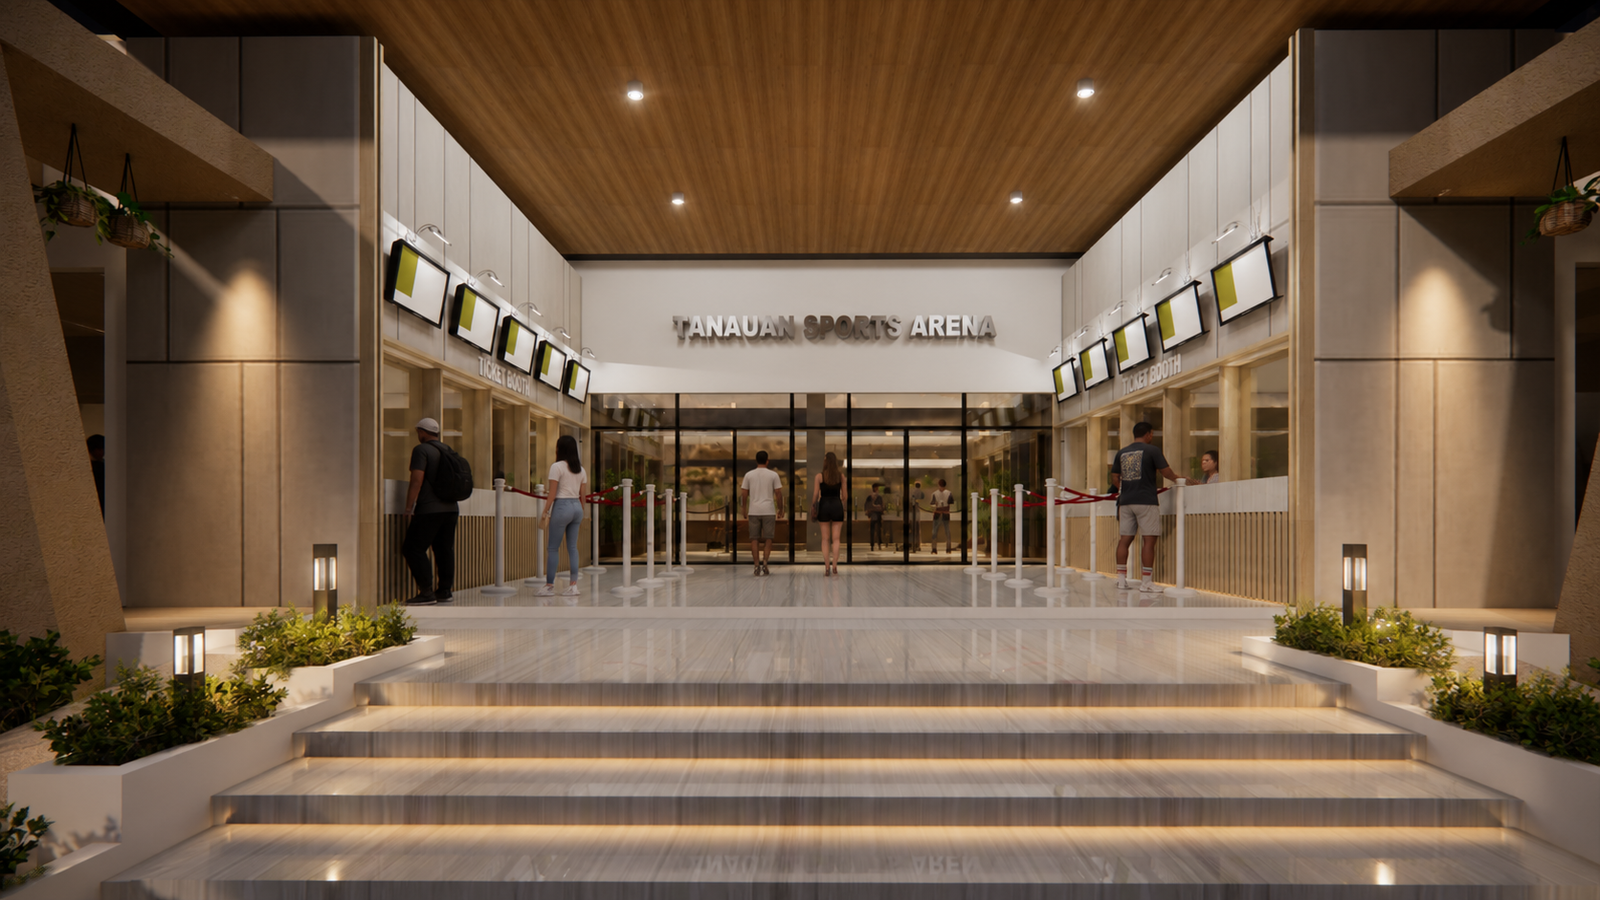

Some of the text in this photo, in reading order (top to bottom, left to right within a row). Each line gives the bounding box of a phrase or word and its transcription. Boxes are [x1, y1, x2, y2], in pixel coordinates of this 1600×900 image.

[672, 314, 997, 340] TANAUAN SPORTS ARENA
[478, 356, 530, 397] TICKET BOOTH
[1122, 353, 1182, 395] TICKET BOOTH
